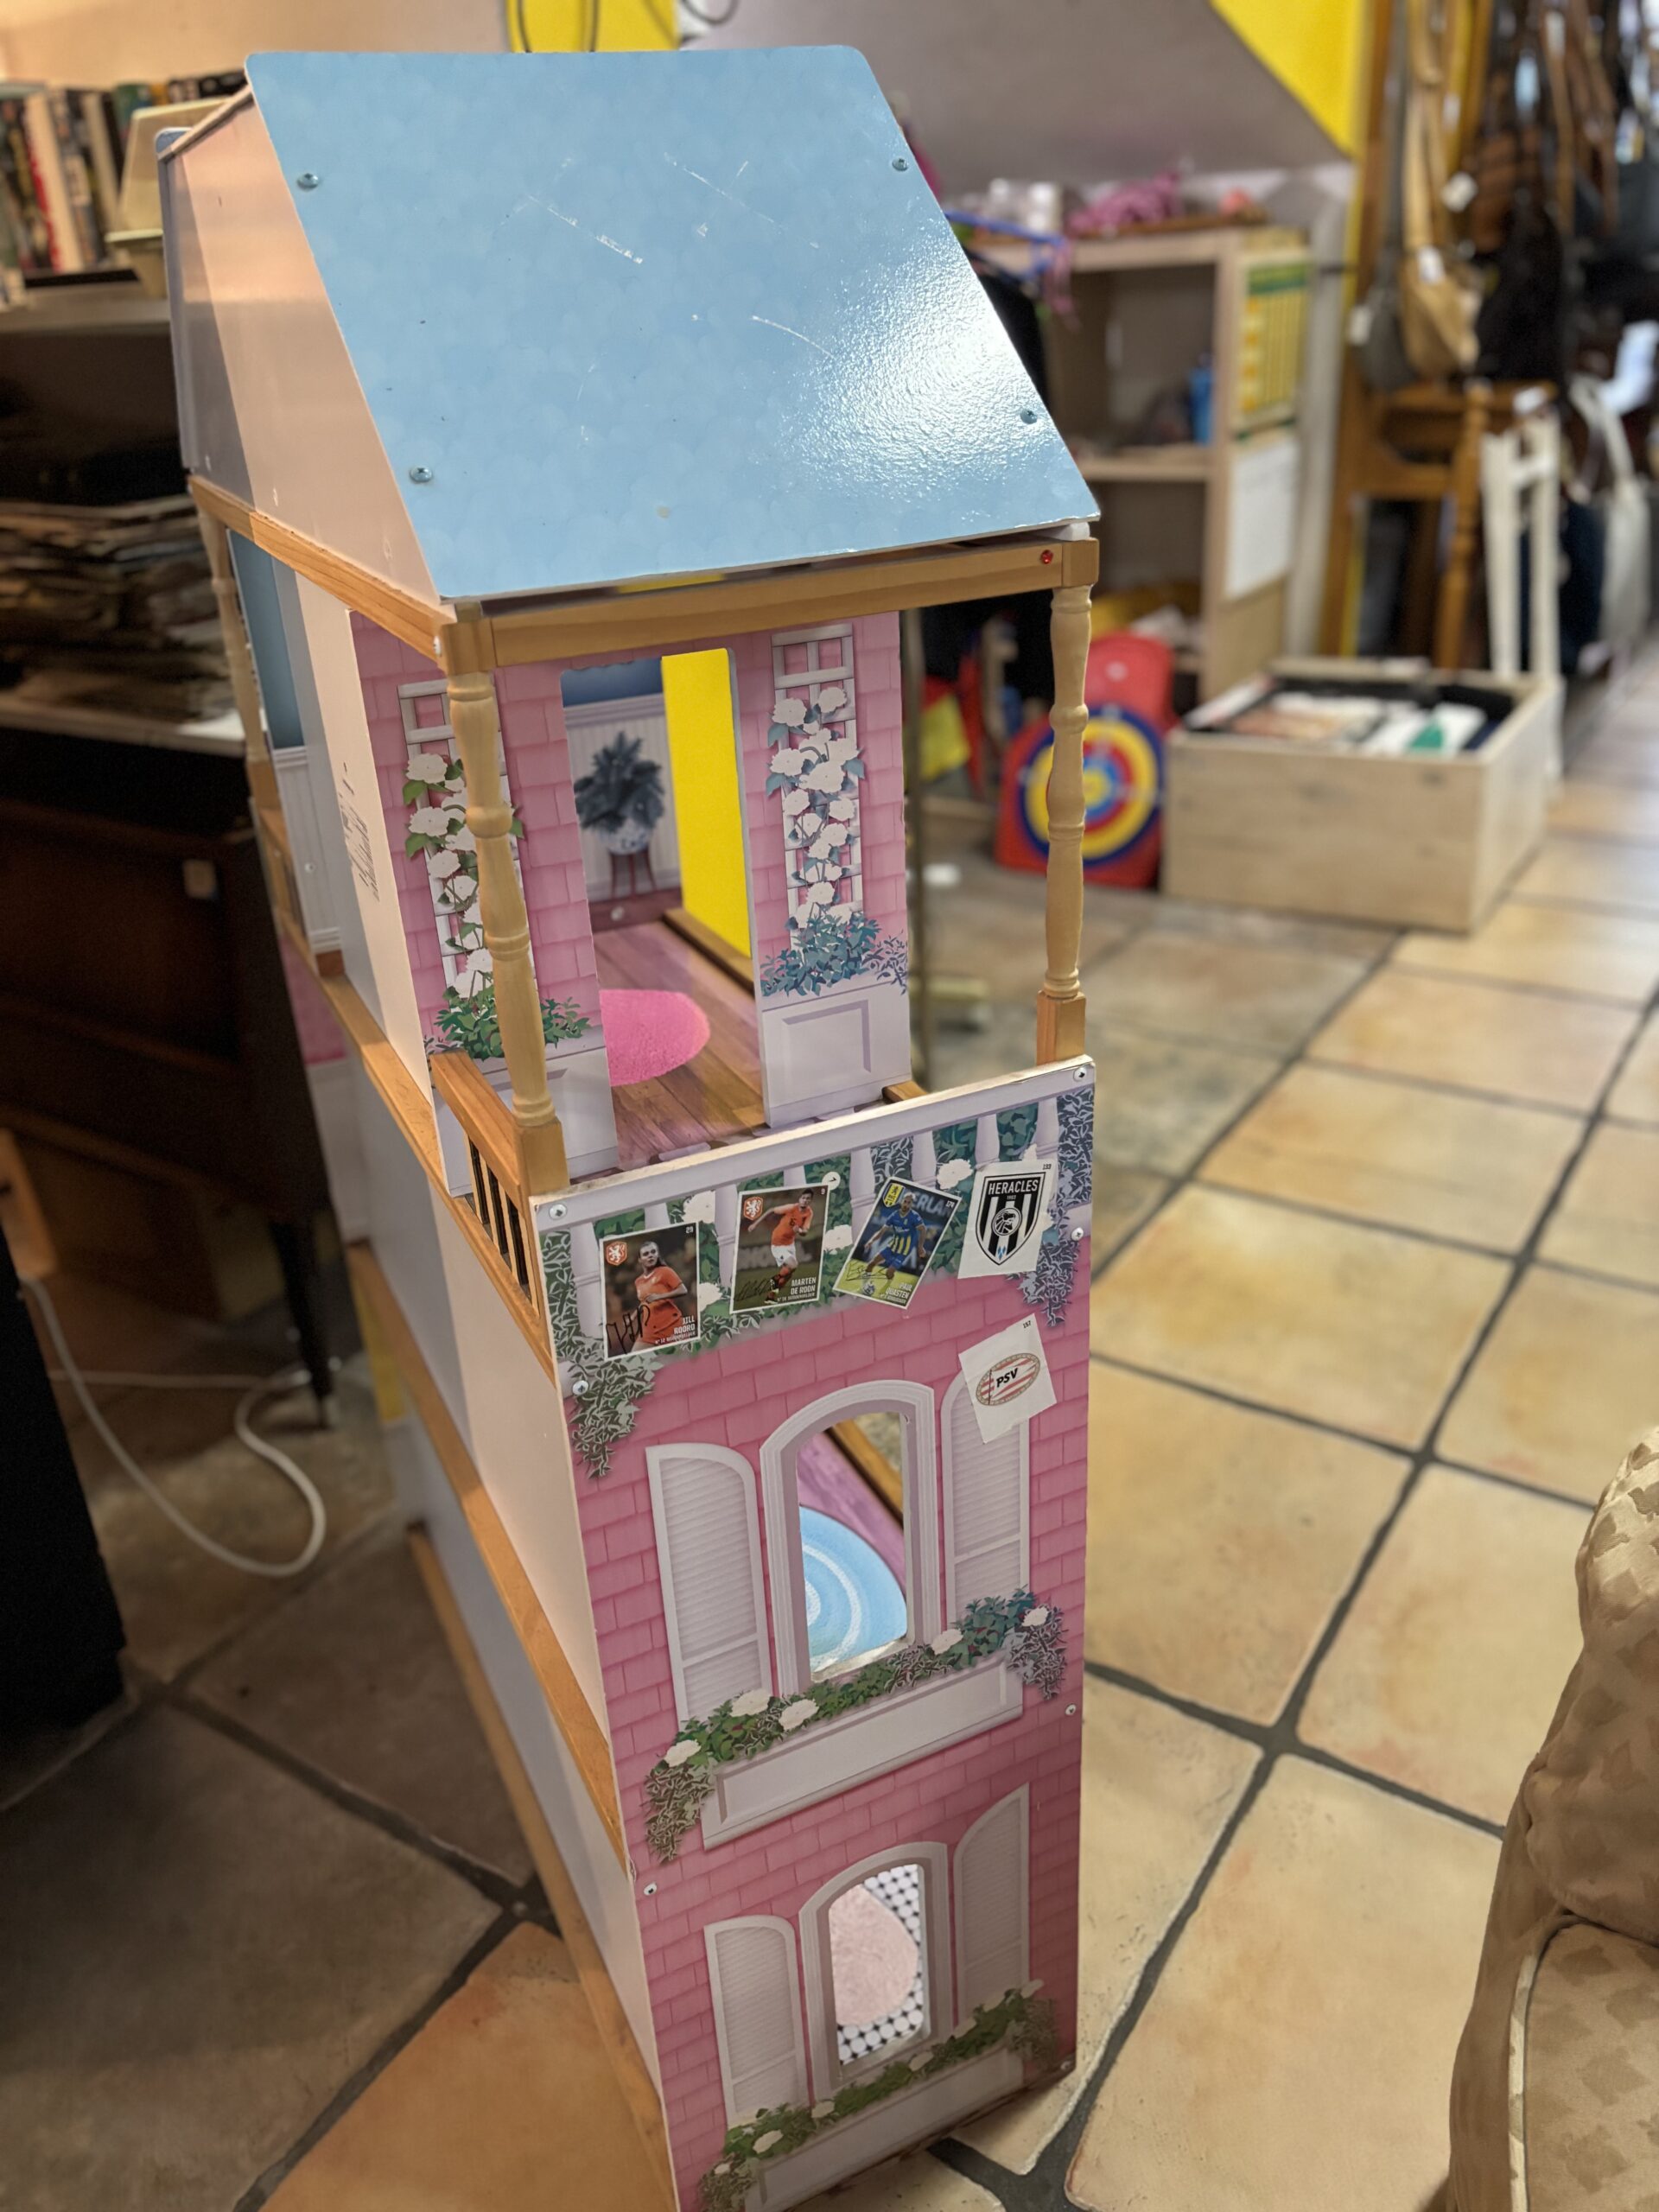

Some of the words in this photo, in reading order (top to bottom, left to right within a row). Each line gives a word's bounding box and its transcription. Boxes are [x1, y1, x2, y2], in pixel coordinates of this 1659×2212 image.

[988, 1179, 1039, 1195] HERACLES
[791, 1277, 817, 1287] MARTEN
[791, 1287, 798, 1295] DE
[996, 1368, 1018, 1388] PSV
